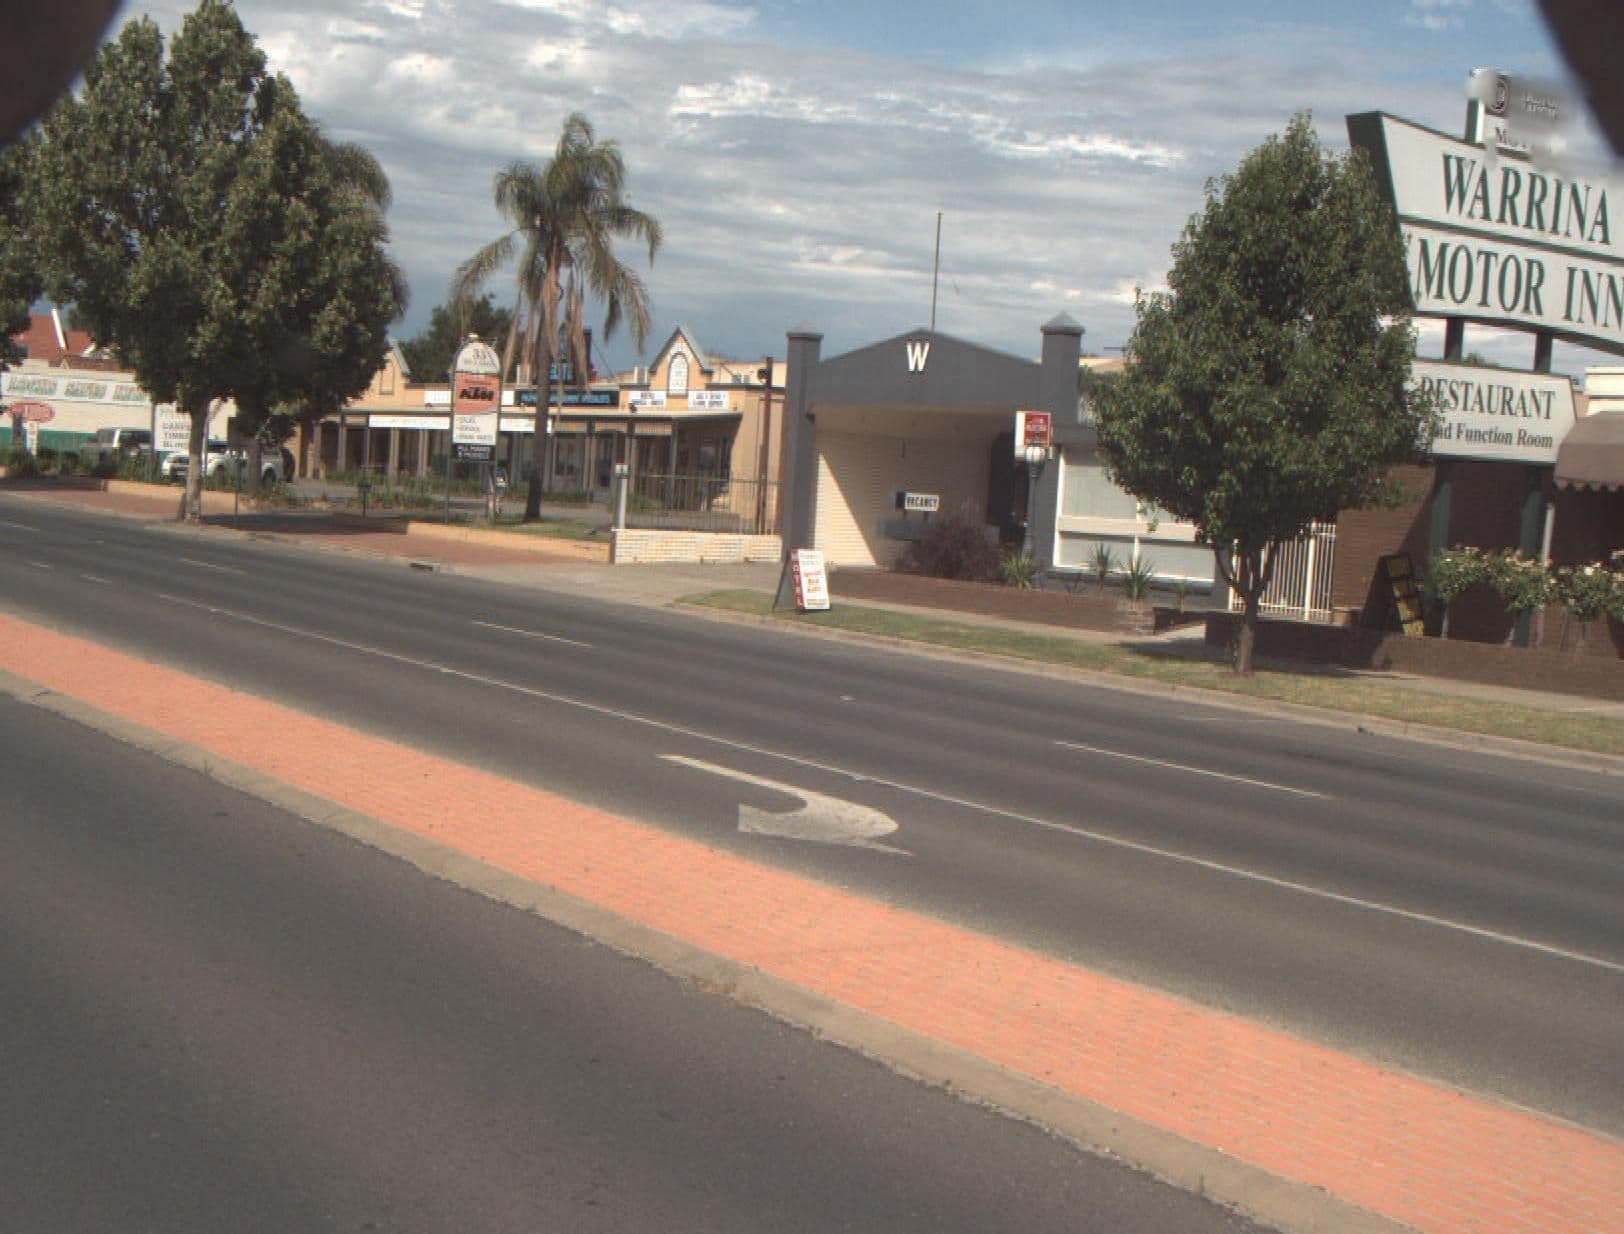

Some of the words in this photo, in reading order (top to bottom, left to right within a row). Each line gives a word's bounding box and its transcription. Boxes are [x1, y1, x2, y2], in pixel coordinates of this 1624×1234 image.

[1443, 153, 1611, 246] WARRINA
[1413, 238, 1546, 317] MOTOR
[1561, 266, 1624, 332] INN
[906, 341, 930, 372] W
[1421, 376, 1556, 420] RESTAURANT
[1455, 422, 1513, 446] Function
[1517, 428, 1554, 448] Room
